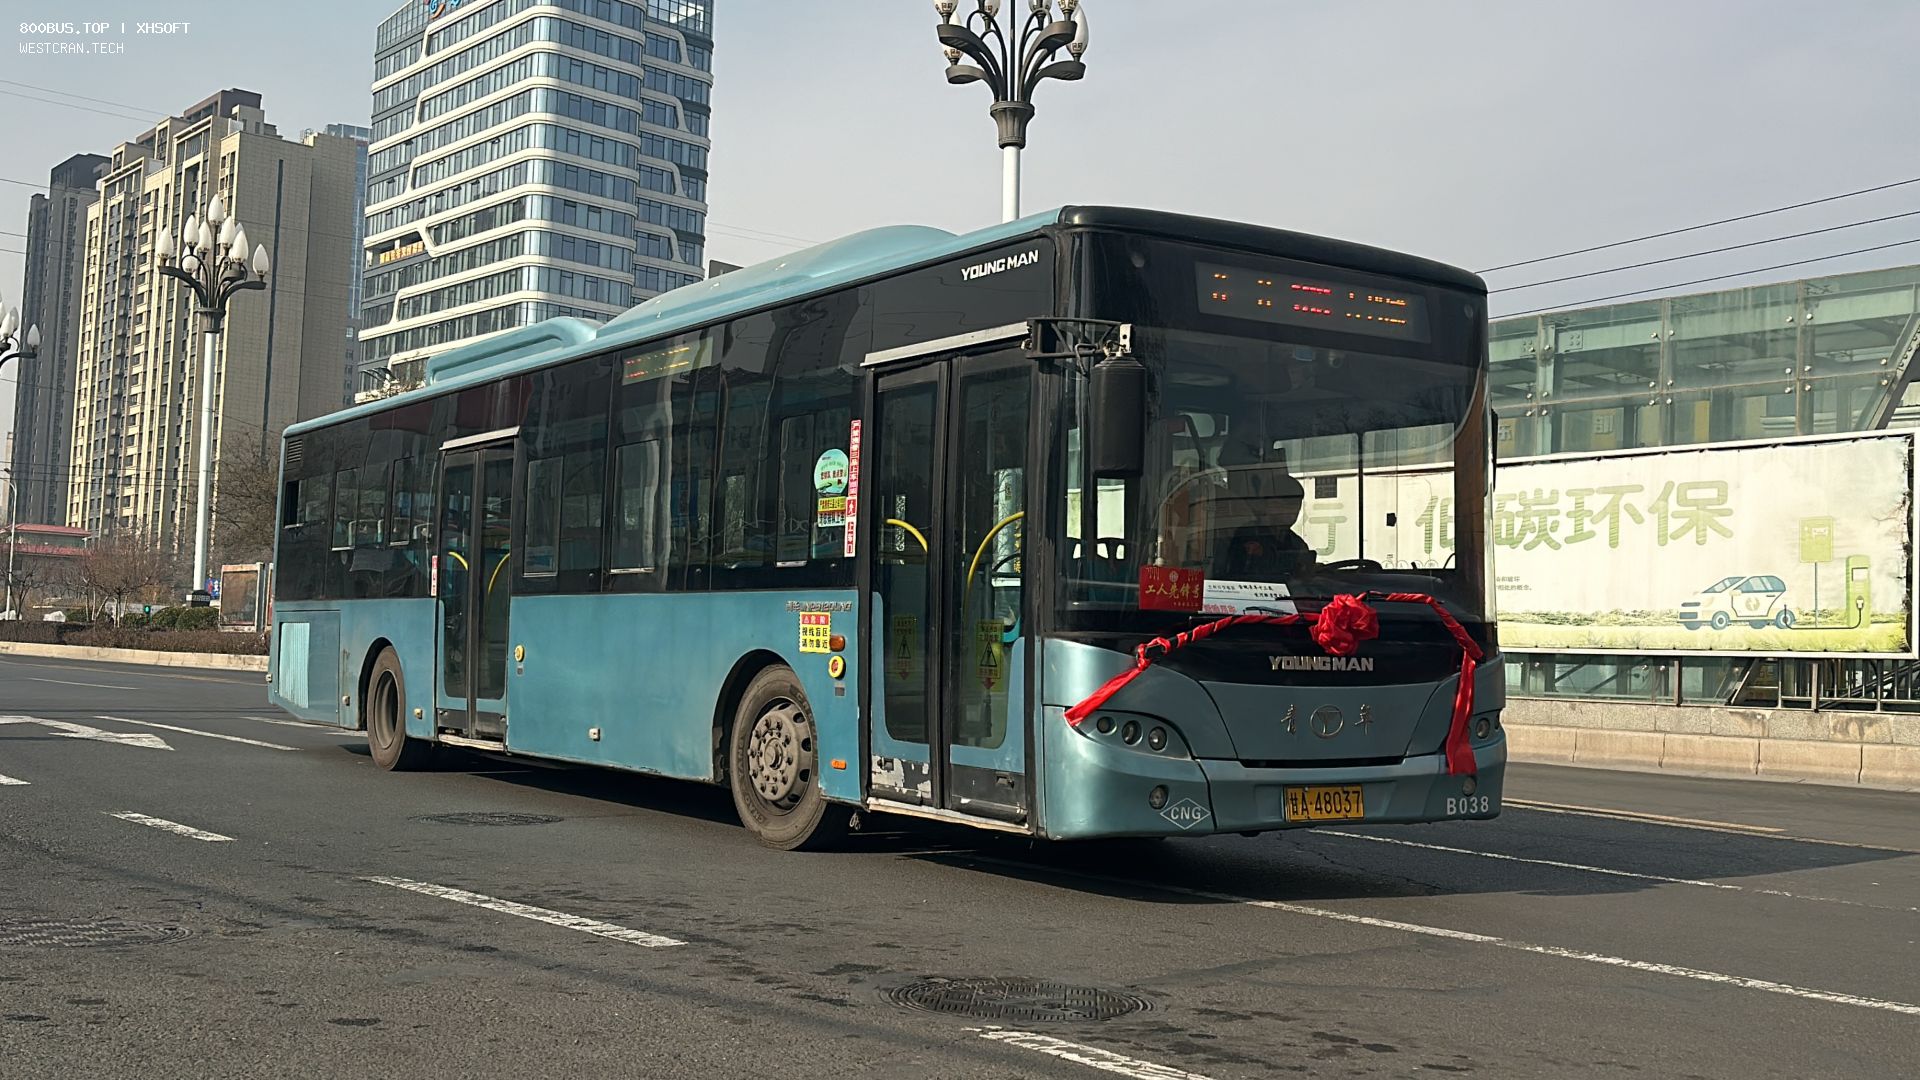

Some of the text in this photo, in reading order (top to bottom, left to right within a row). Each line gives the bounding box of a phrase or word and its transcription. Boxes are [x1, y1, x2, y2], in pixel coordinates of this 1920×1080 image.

[1268, 655, 1374, 672] YOUNGMAN
[1170, 806, 1202, 820] CNG
[1446, 795, 1490, 816] B038
